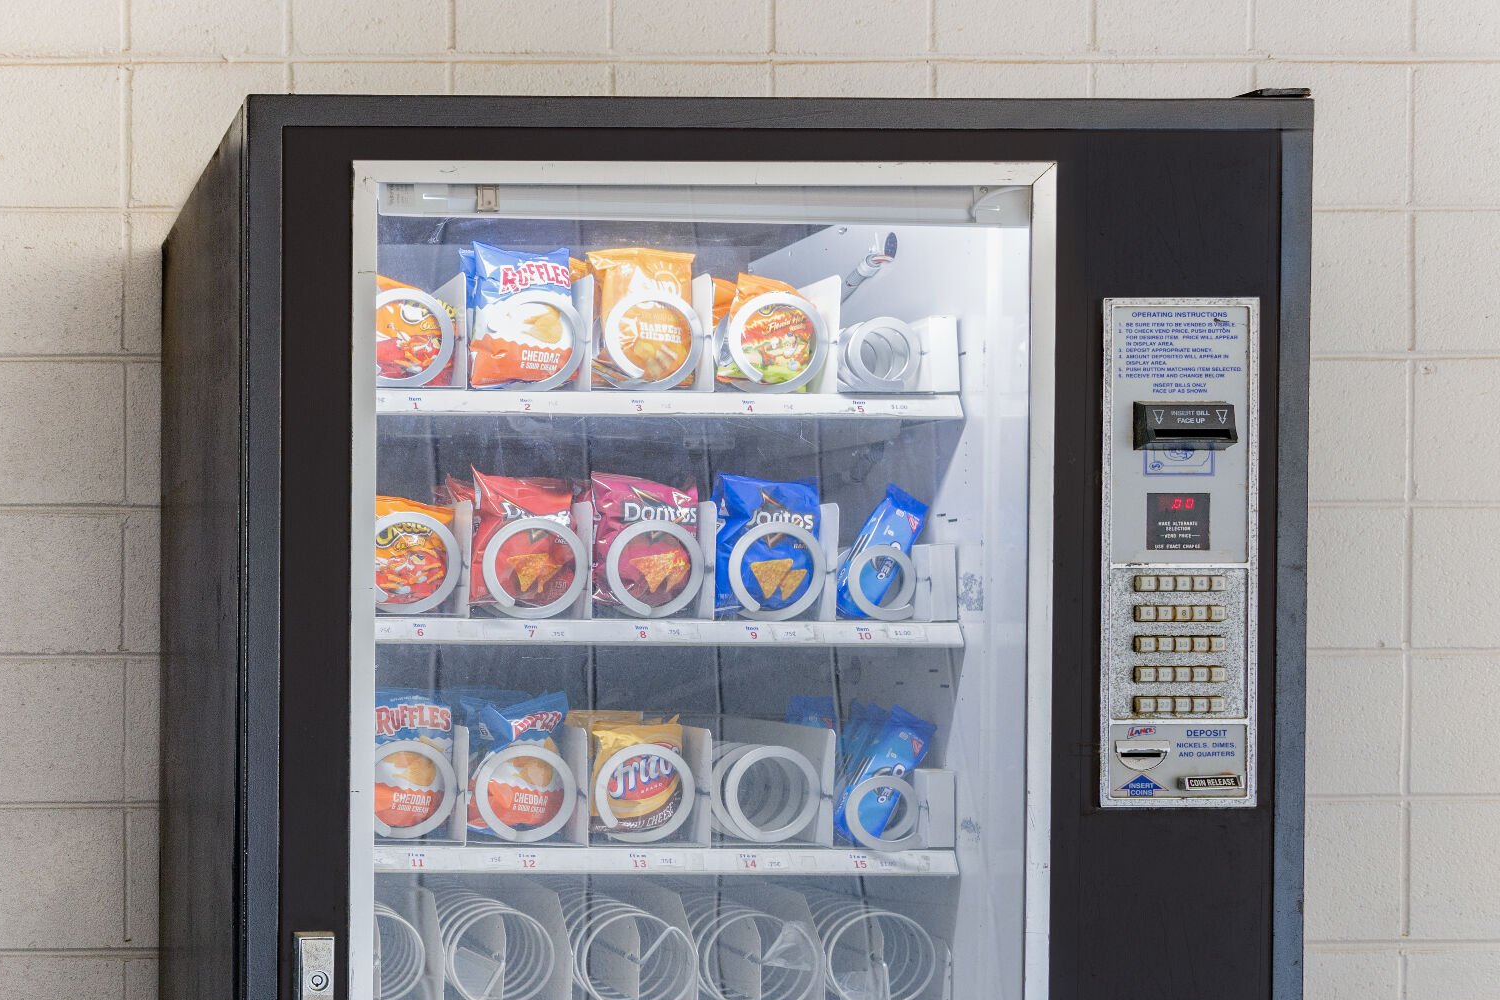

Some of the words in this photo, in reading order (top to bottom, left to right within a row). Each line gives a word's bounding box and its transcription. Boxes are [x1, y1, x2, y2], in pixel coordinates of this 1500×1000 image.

[501, 263, 570, 292] RUFFLES
[640, 322, 682, 335] HARVEST
[640, 331, 682, 344] CHEDDAR
[522, 350, 560, 364] CHEDDAR
[624, 502, 697, 522] Doritos
[417, 628, 424, 636] 6
[376, 704, 451, 735] RUFFLES
[609, 754, 675, 797] Frito
[1206, 778, 1236, 786] RELEASE
[641, 783, 662, 794] BRAND
[394, 792, 432, 806] CHEDDAR
[515, 792, 548, 806] CHEDDAR
[412, 858, 424, 866] 11
[634, 860, 646, 868] 13
[744, 860, 756, 868] 14
[854, 860, 868, 868] 15
